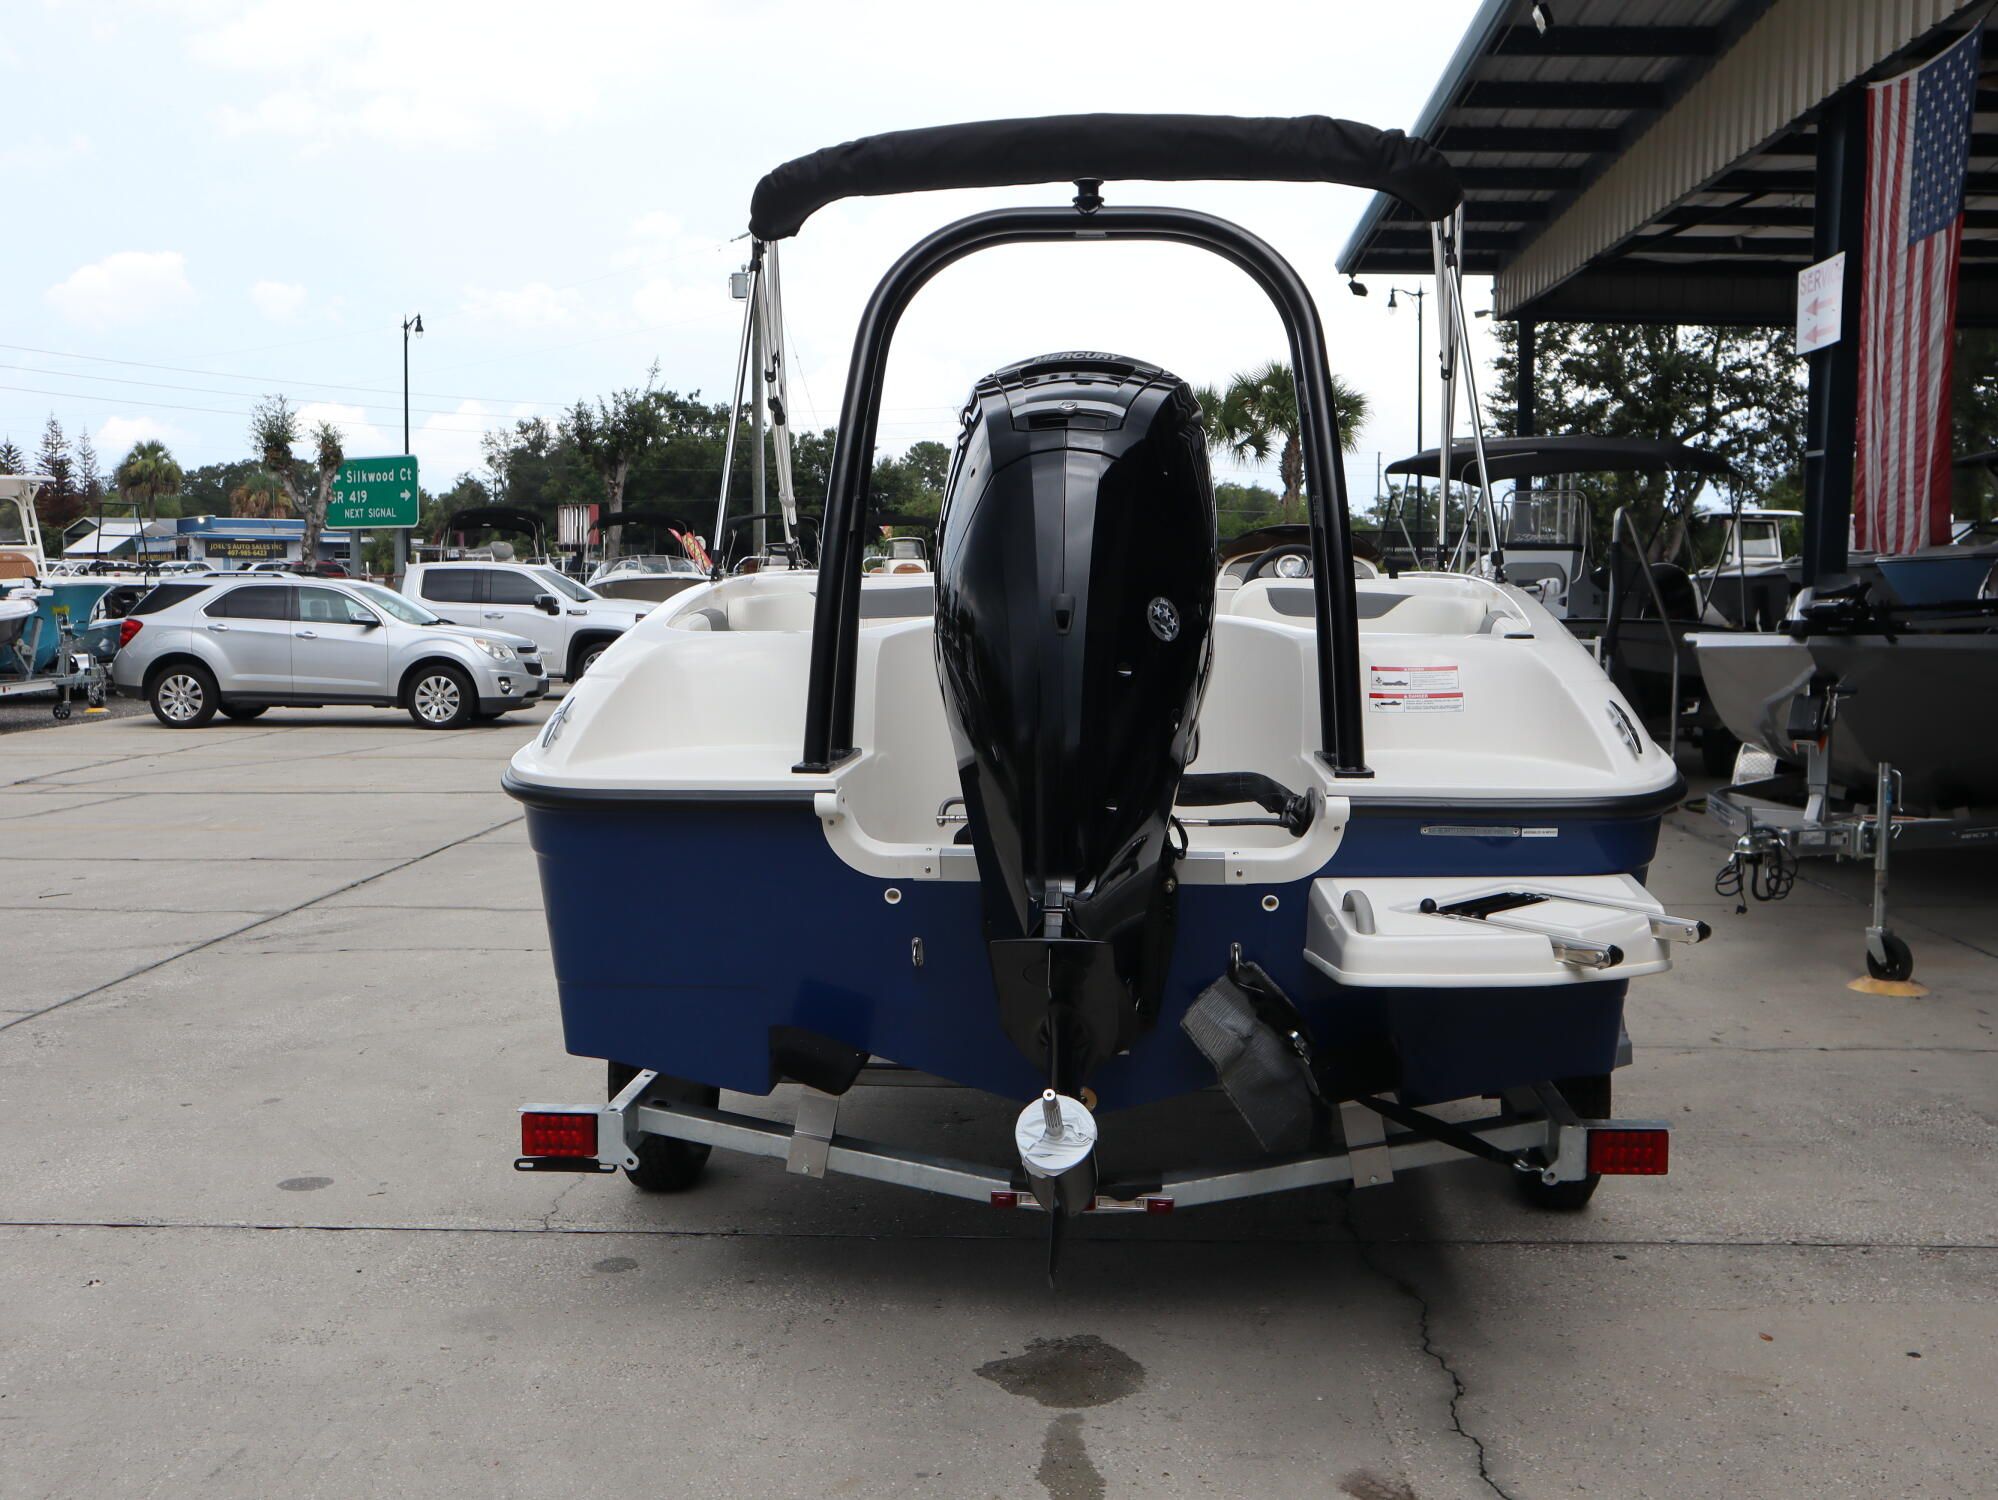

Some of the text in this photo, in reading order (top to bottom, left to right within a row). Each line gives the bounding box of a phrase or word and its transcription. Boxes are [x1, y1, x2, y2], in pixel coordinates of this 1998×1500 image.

[1032, 352, 1122, 364] MERCURY
[346, 467, 412, 483] Silkwood Ct
[349, 490, 368, 503] 419
[344, 507, 397, 519] NEXT SIGNAL
[209, 543, 231, 551] JOEL'S
[271, 543, 283, 551] INC
